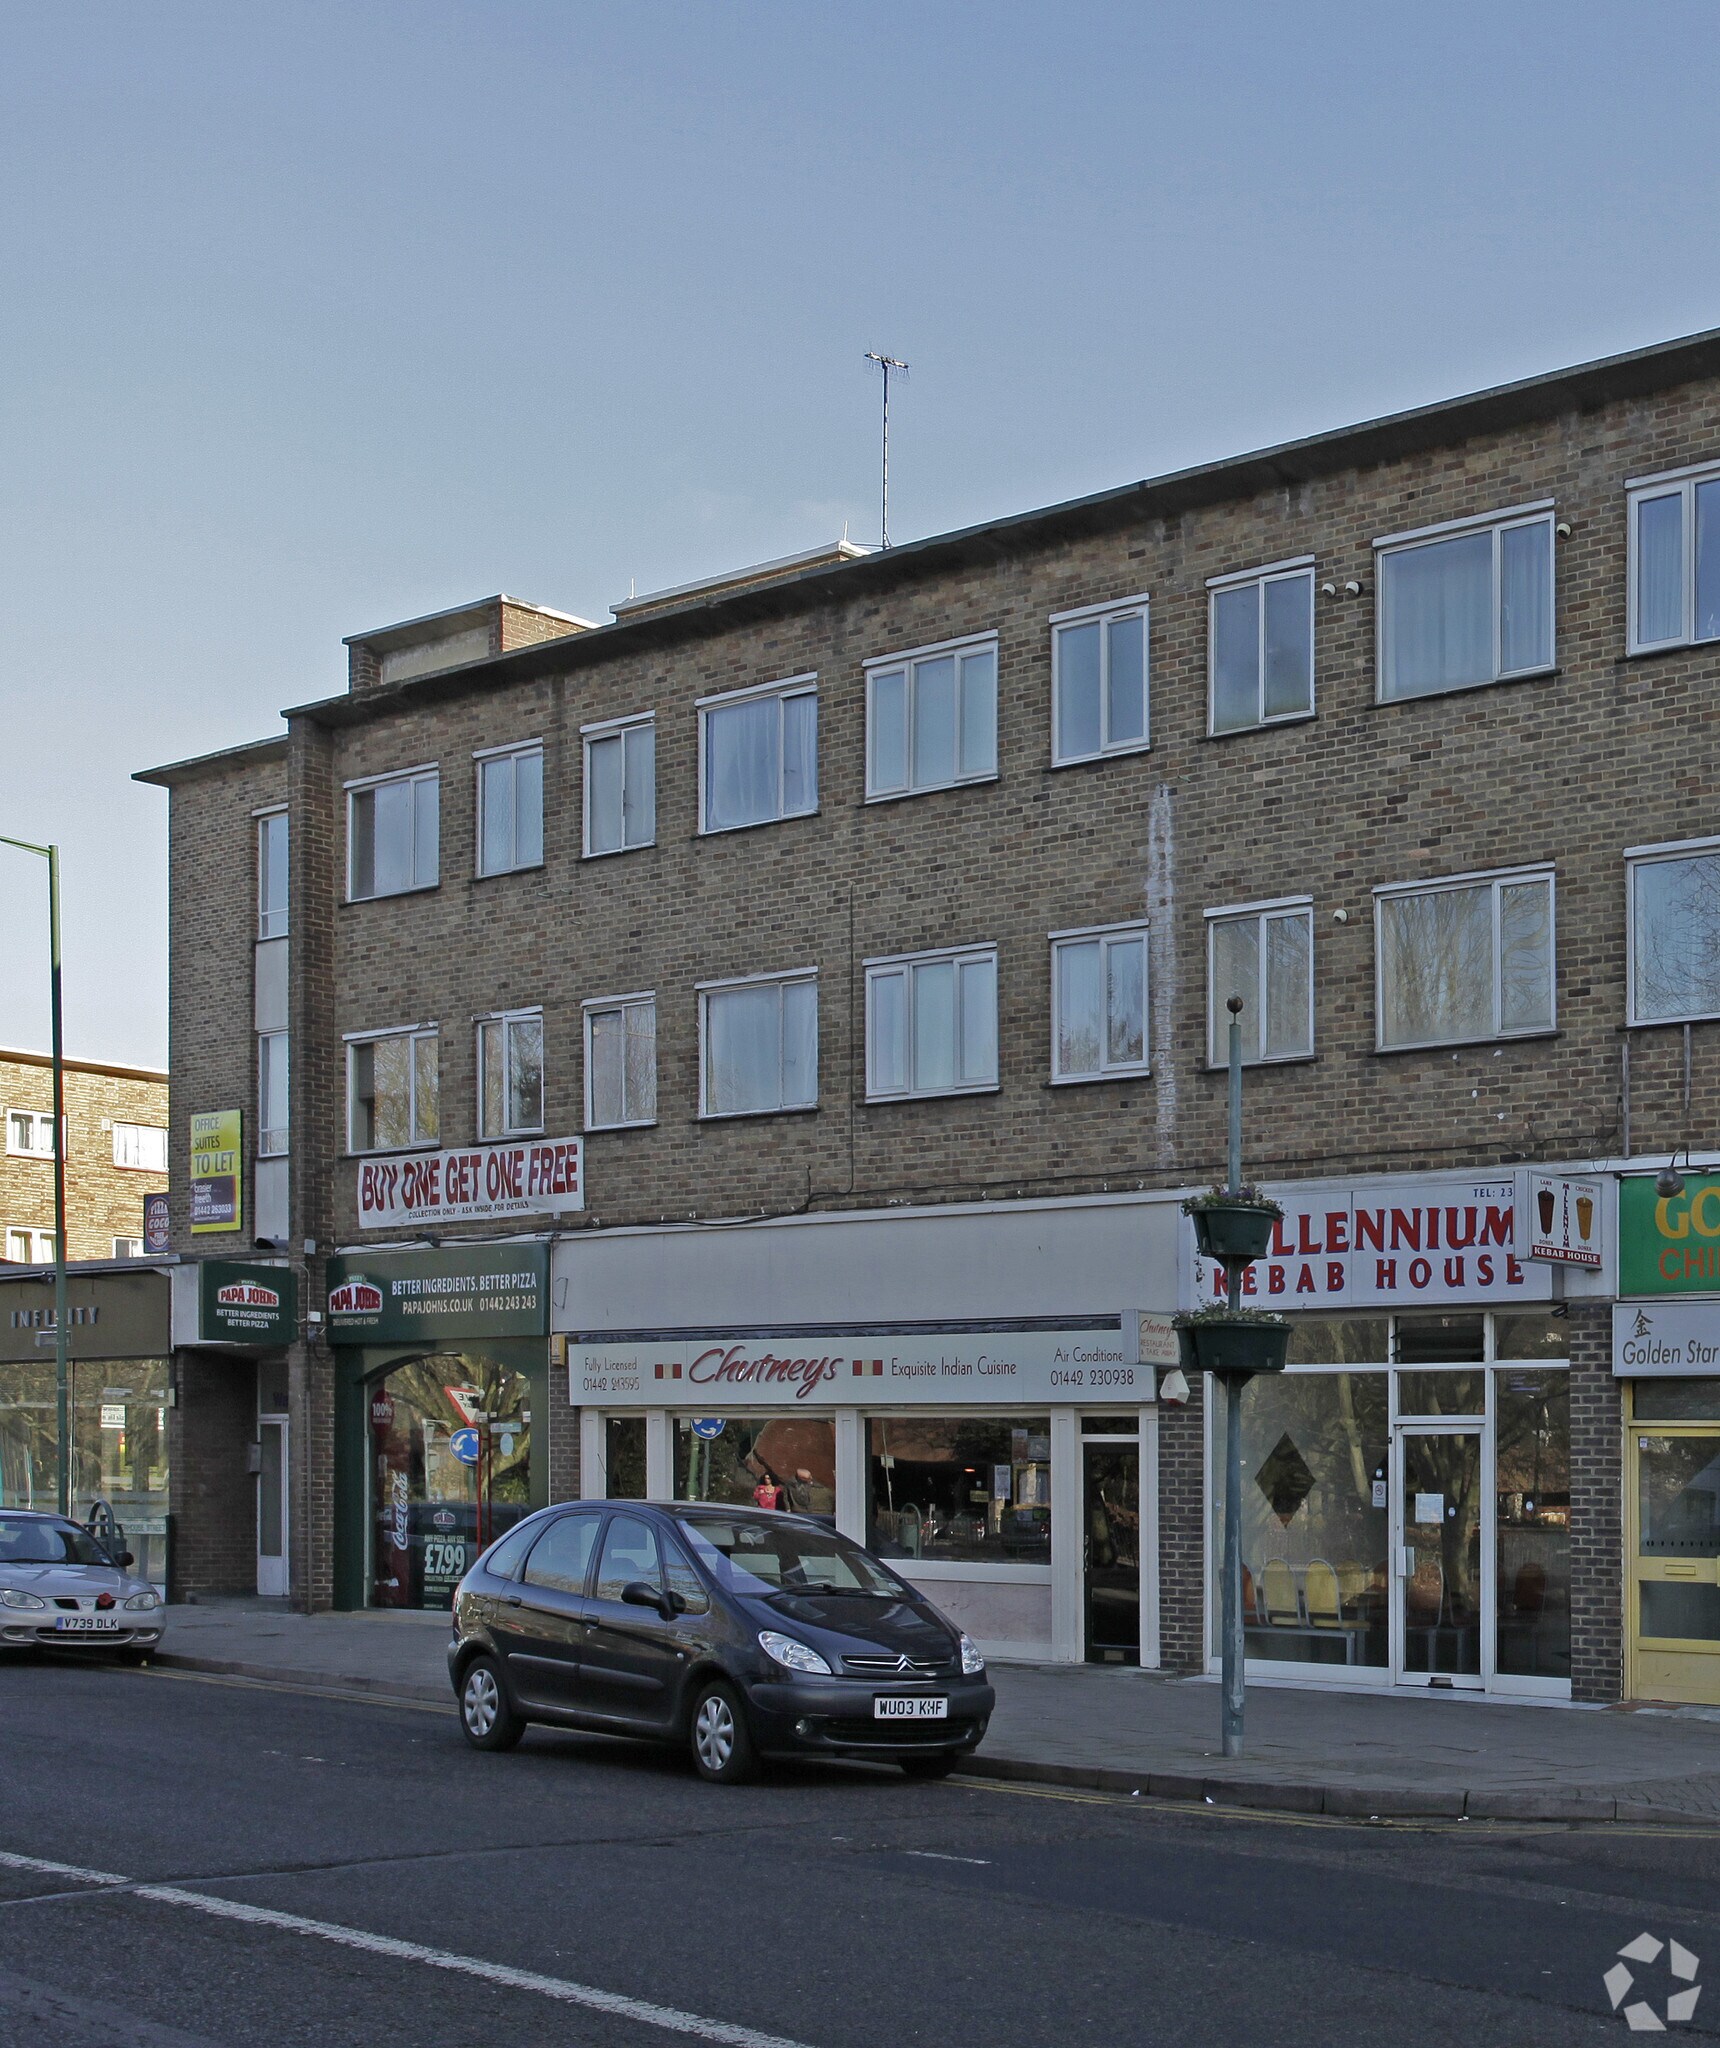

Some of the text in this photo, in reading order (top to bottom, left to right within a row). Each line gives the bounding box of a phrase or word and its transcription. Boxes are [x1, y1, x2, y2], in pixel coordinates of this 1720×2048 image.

[195, 1117, 219, 1131] OFFICE
[195, 1136, 220, 1150] SUITES
[195, 1152, 235, 1174] TO LET
[362, 1144, 578, 1212] BUY ONE GET ONE FREE
[1473, 1187, 1513, 1198] TEL: 23
[1575, 1185, 1594, 1194] CHICKEN
[408, 1208, 441, 1219] COLLECTION
[442, 1207, 456, 1216] ONLY
[462, 1205, 473, 1214] ASK
[475, 1204, 492, 1213] INSIDE
[494, 1203, 505, 1212] FOR
[506, 1201, 529, 1210] DETAILS
[1213, 1205, 1514, 1257] LLENNIUM
[1534, 1246, 1598, 1263] KEBAB HOUSE
[1658, 1247, 1720, 1280] CHI
[1213, 1253, 1525, 1297] KEBAB HOUSE
[392, 1272, 537, 1296] BETTER INGREDIENTS. BETTER PIZZA
[220, 1287, 246, 1303] PAPA
[331, 1286, 353, 1311] PAPA
[402, 1295, 537, 1315] PAPAJOHNS.CO.UK 01442 243 243
[216, 1308, 280, 1320] BETTER INGREDIENTS
[227, 1319, 269, 1328] BETTER PIZZA
[1140, 1319, 1174, 1341] Chutney
[1630, 1308, 1654, 1339] 金
[1141, 1339, 1175, 1350] RESTAURANT
[1146, 1348, 1160, 1356] TAKE
[1622, 1339, 1720, 1365] Golden Star
[1054, 1346, 1123, 1363] Air Conditione
[585, 1356, 638, 1373] Fully Licensed
[688, 1345, 844, 1399] Chutneys
[891, 1355, 1017, 1379] Exquisite Indian Cuisine
[583, 1377, 607, 1391] 01442
[1050, 1369, 1134, 1386] 01442 230938
[372, 1403, 392, 1416] 100%
[424, 1543, 465, 1575] £7.99
[64, 1618, 118, 1629] V739 DLK
[879, 1700, 943, 1715] WU03 KHF
